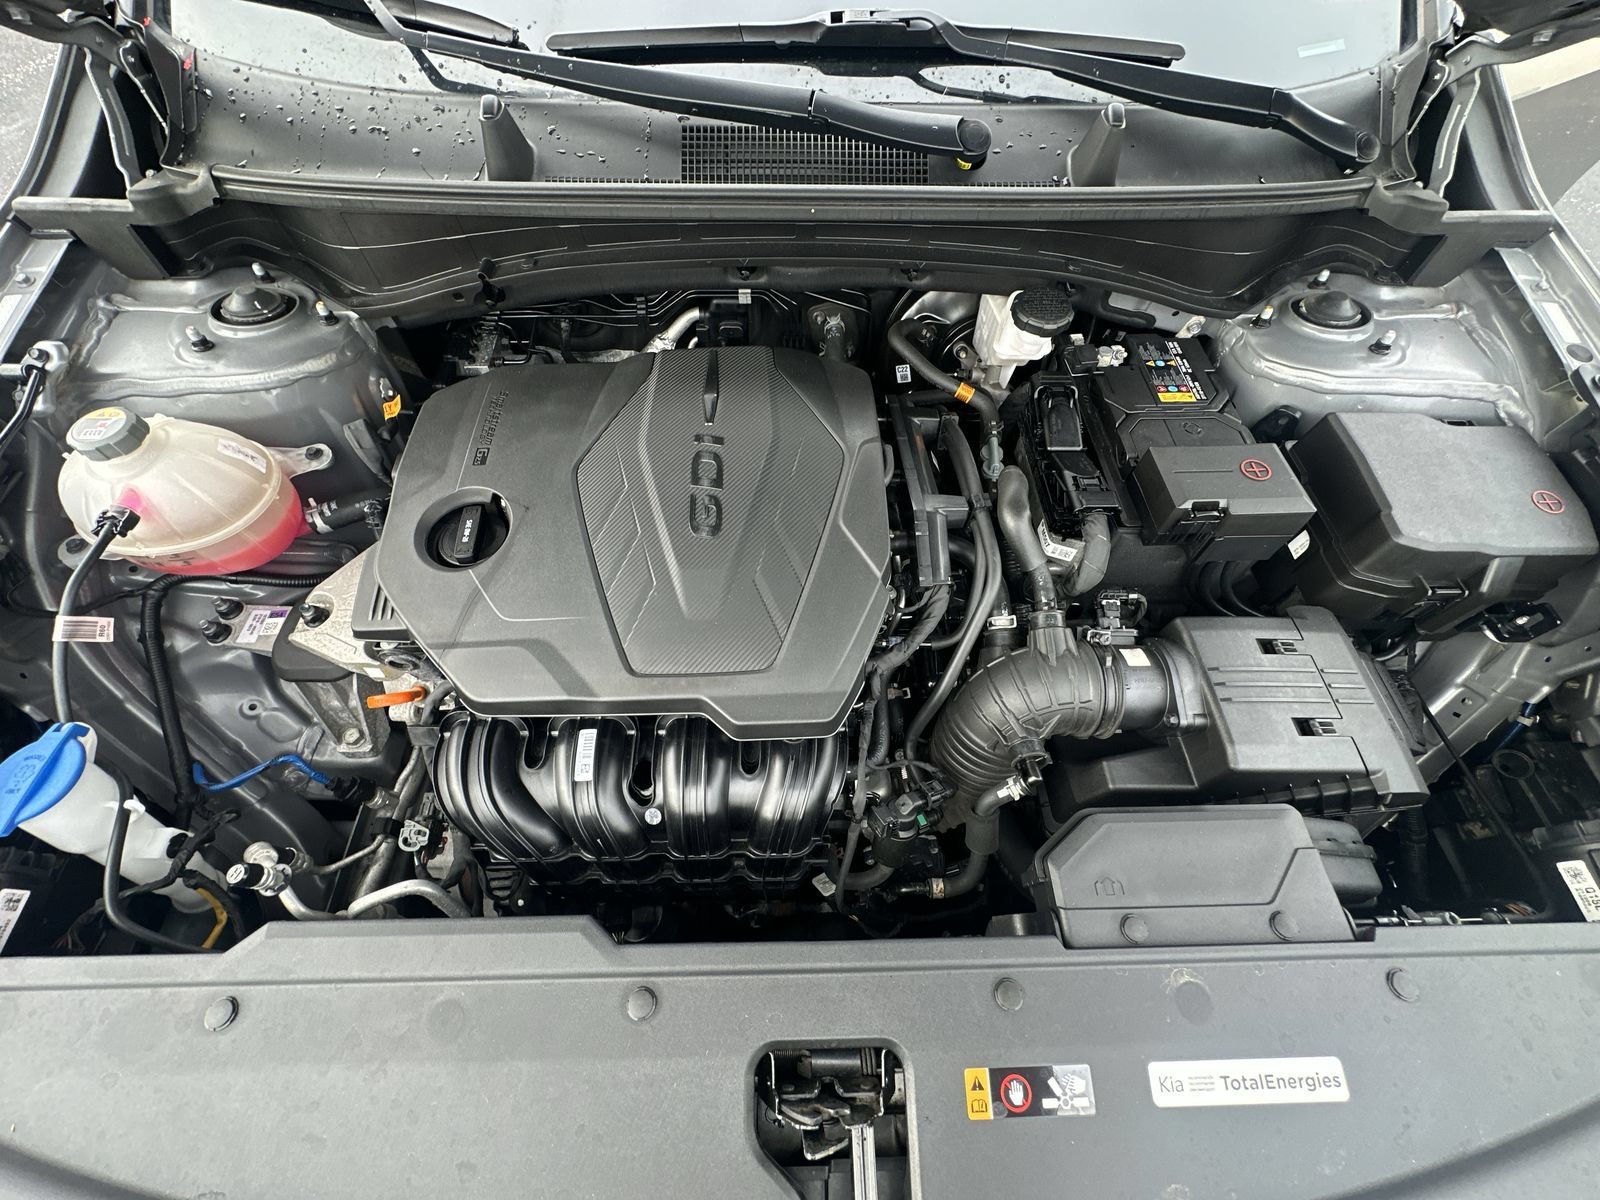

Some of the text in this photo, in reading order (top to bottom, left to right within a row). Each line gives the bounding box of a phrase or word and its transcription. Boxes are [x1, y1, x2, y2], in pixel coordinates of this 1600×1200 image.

[485, 390, 509, 446] Smartstream
[1158, 1075, 1185, 1093] Kia
[1219, 1072, 1342, 1092] TotalEnergies
